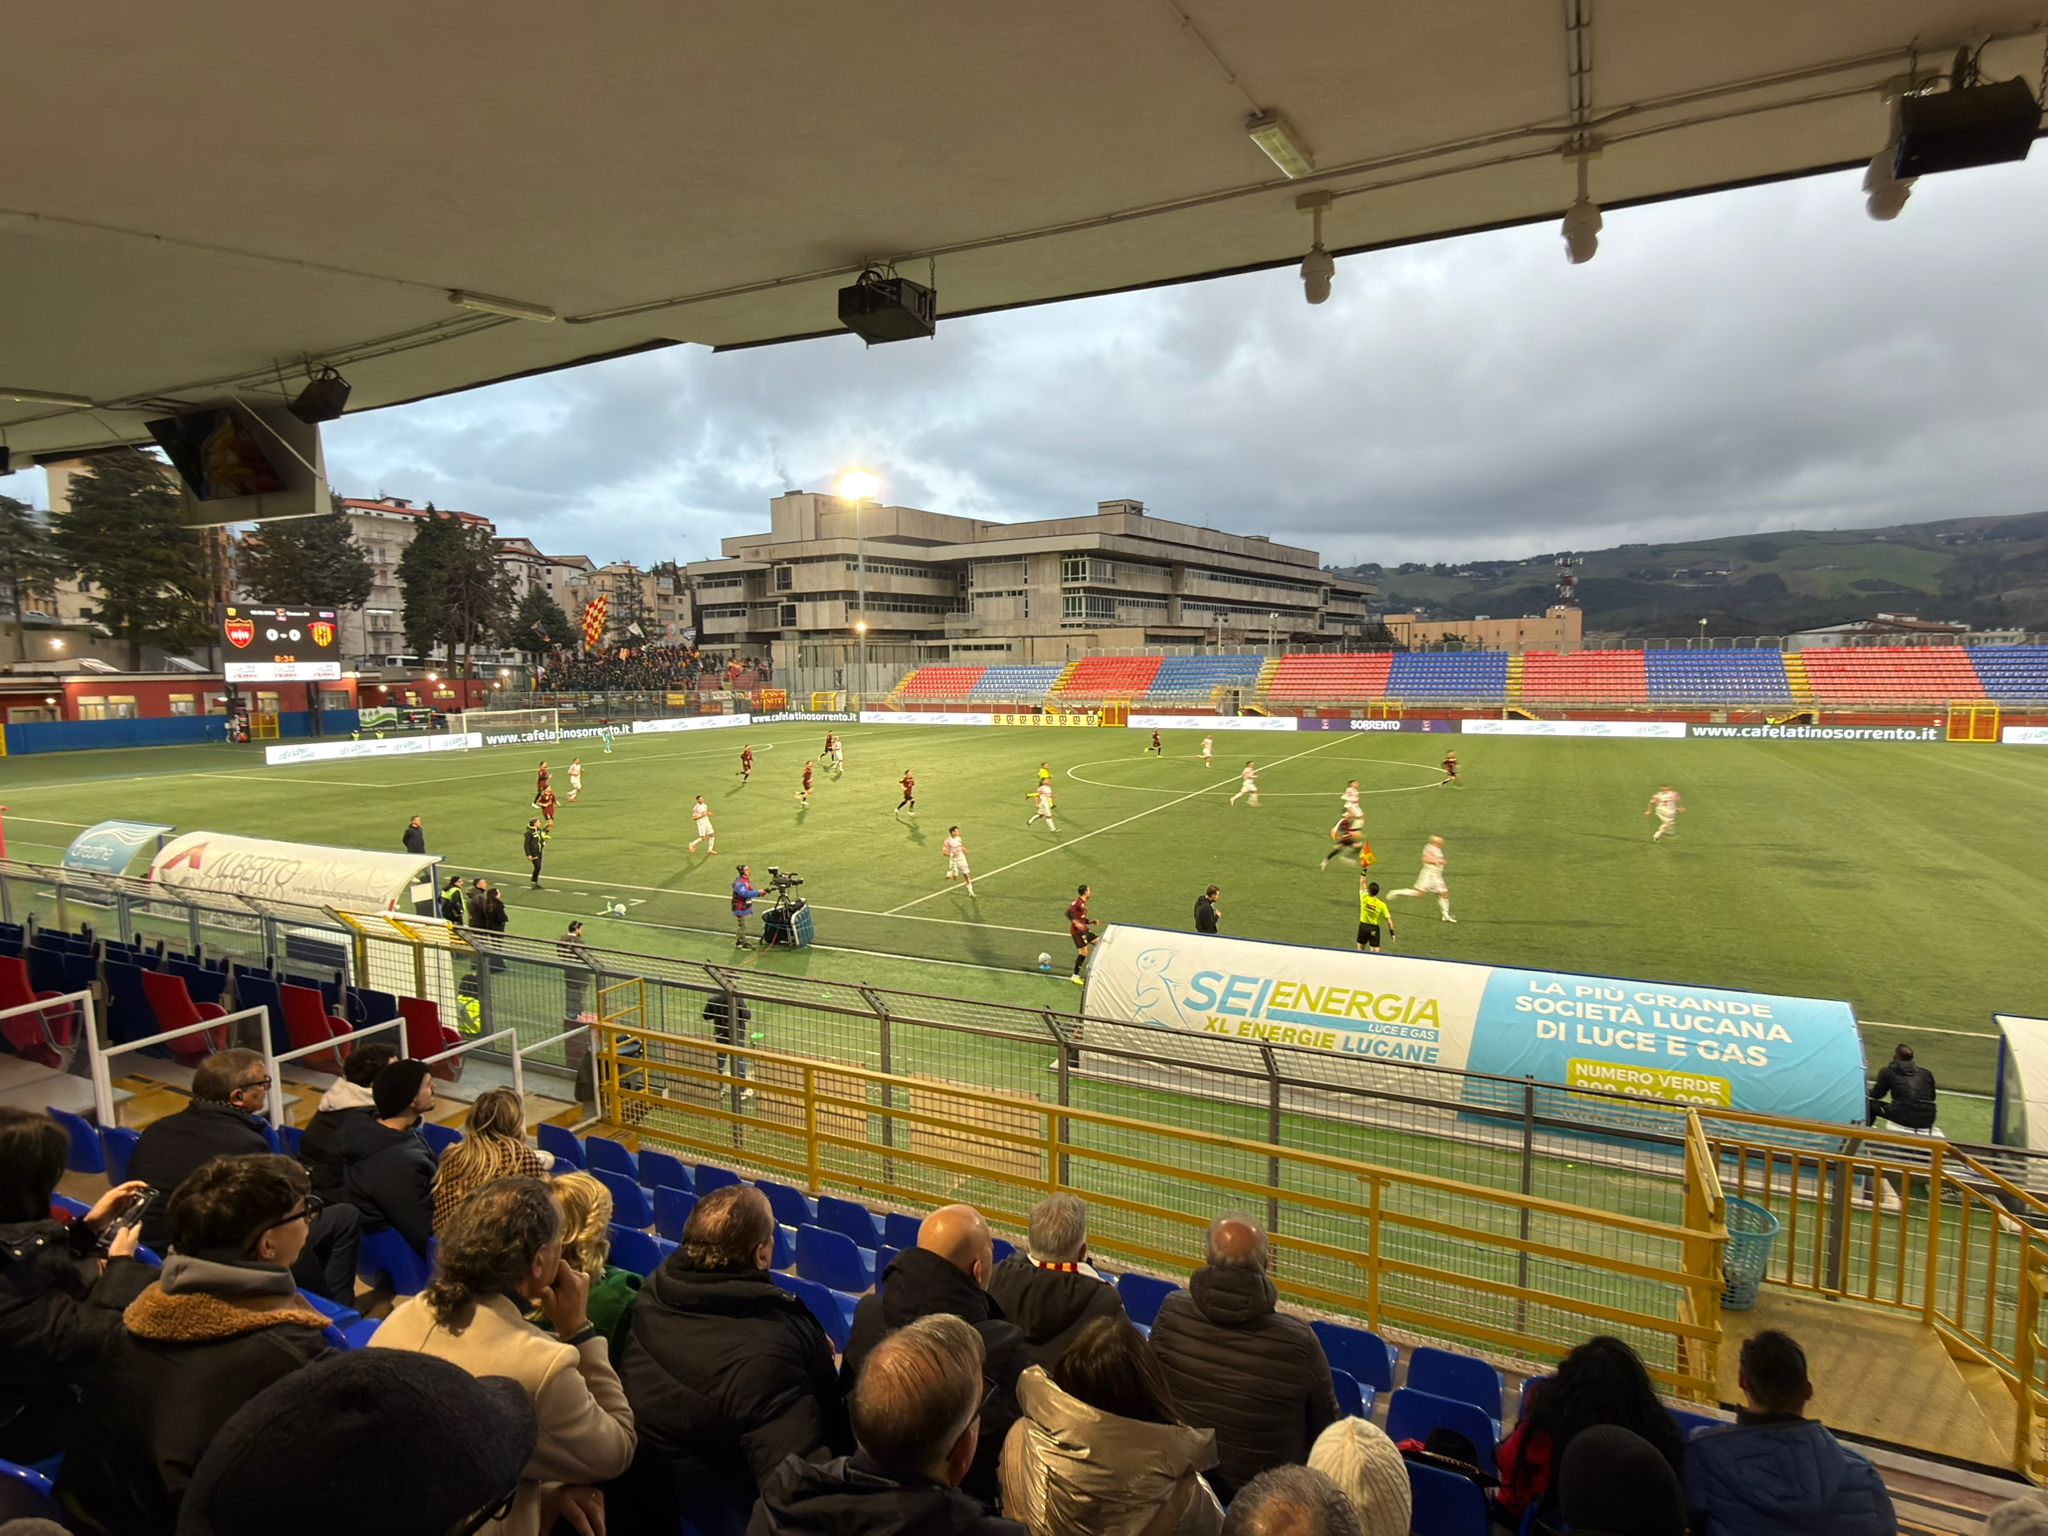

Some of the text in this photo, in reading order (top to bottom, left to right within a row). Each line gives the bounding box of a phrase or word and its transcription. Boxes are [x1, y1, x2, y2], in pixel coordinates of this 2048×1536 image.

[752, 711, 857, 724] www.cafelatinosorrento.it
[1350, 719, 1401, 730] SORRENTO
[1692, 725, 1938, 740] www.cafelatinosorrento.it
[204, 852, 302, 885] ALBERTO
[1529, 980, 1774, 1019] LA PIÙ GRANDE
[1368, 1023, 1436, 1041] LUCE E GAS
[1515, 996, 1793, 1043] SOCIETÀ LUCANA
[1203, 1015, 1440, 1064] XL ENERGIE LUCANE
[1536, 1019, 1768, 1067] DI LUCE E GAS
[1575, 1063, 1655, 1086] NUMERO
[1659, 1074, 1722, 1095] VERDE
